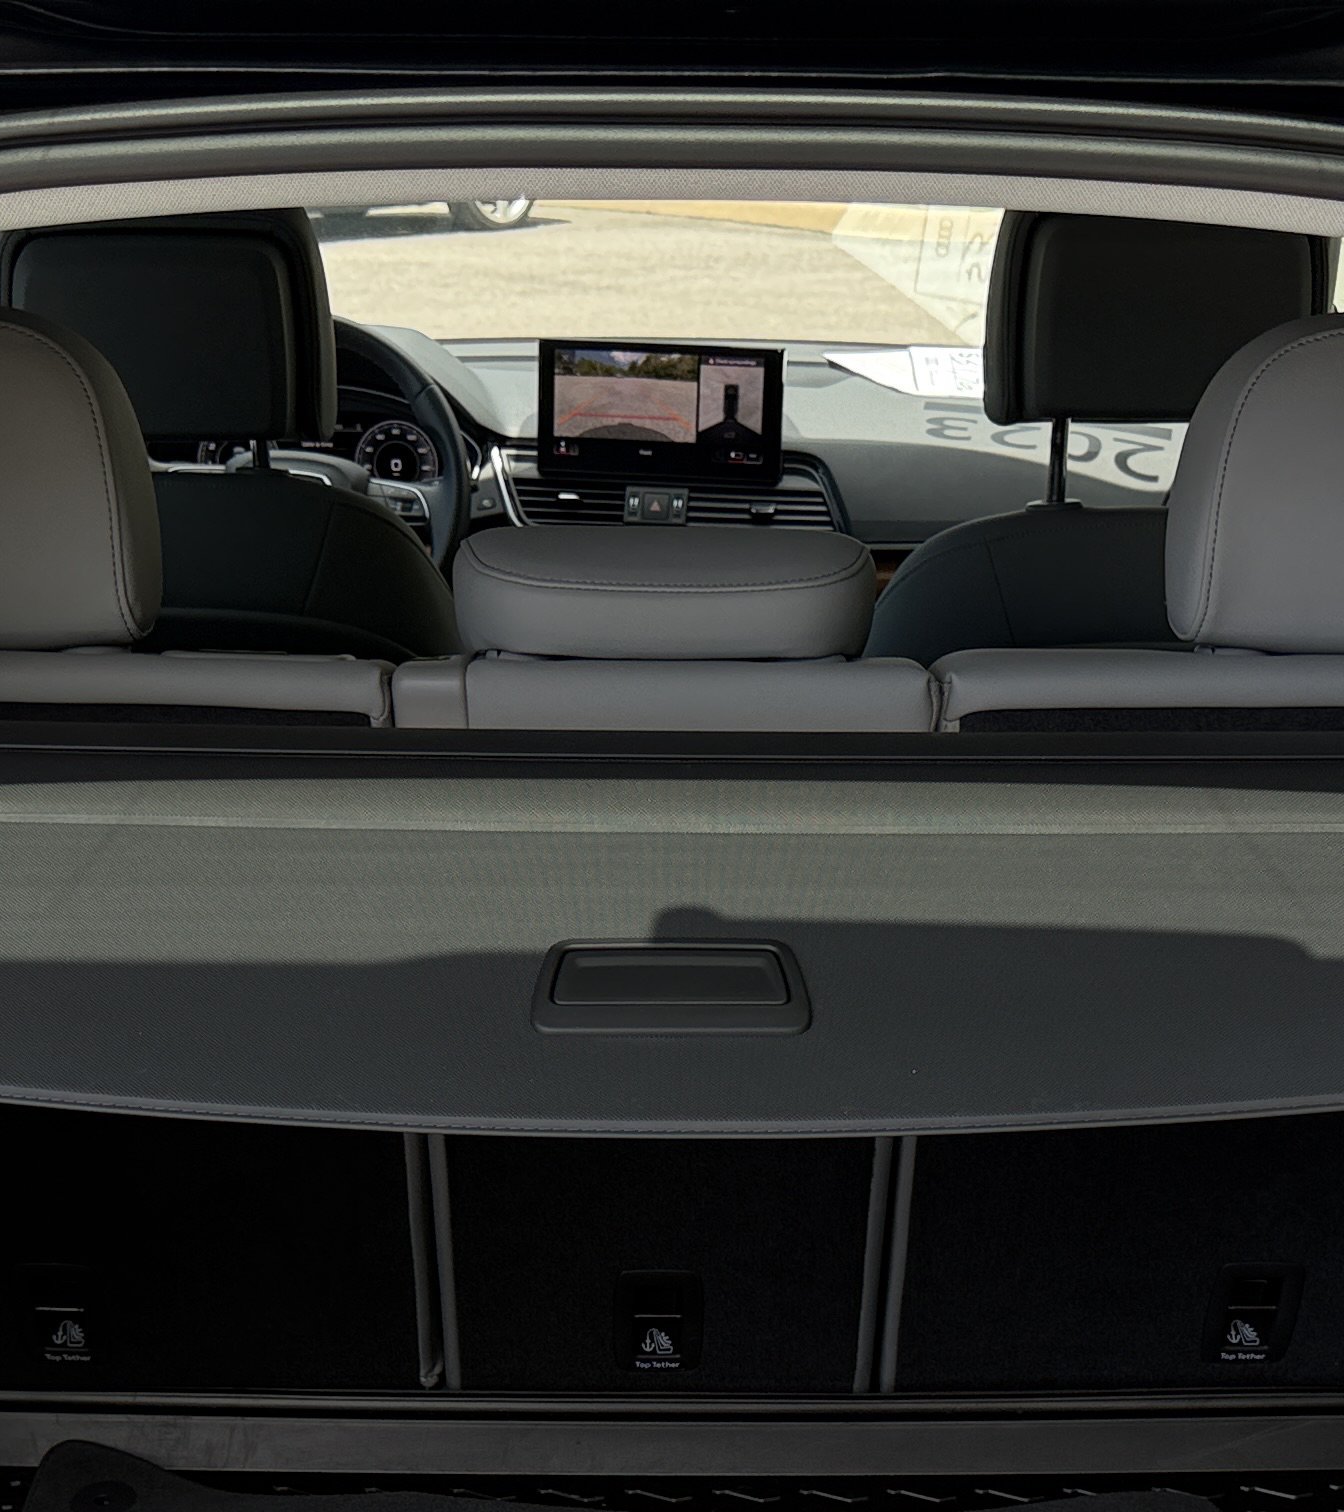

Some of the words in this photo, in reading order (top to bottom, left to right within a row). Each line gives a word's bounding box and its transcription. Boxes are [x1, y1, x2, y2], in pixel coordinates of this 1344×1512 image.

[44, 1353, 62, 1362] Top
[62, 1354, 91, 1362] Tether
[1220, 1352, 1237, 1361] Top
[1237, 1352, 1266, 1360] Tether
[635, 1361, 652, 1369] Top
